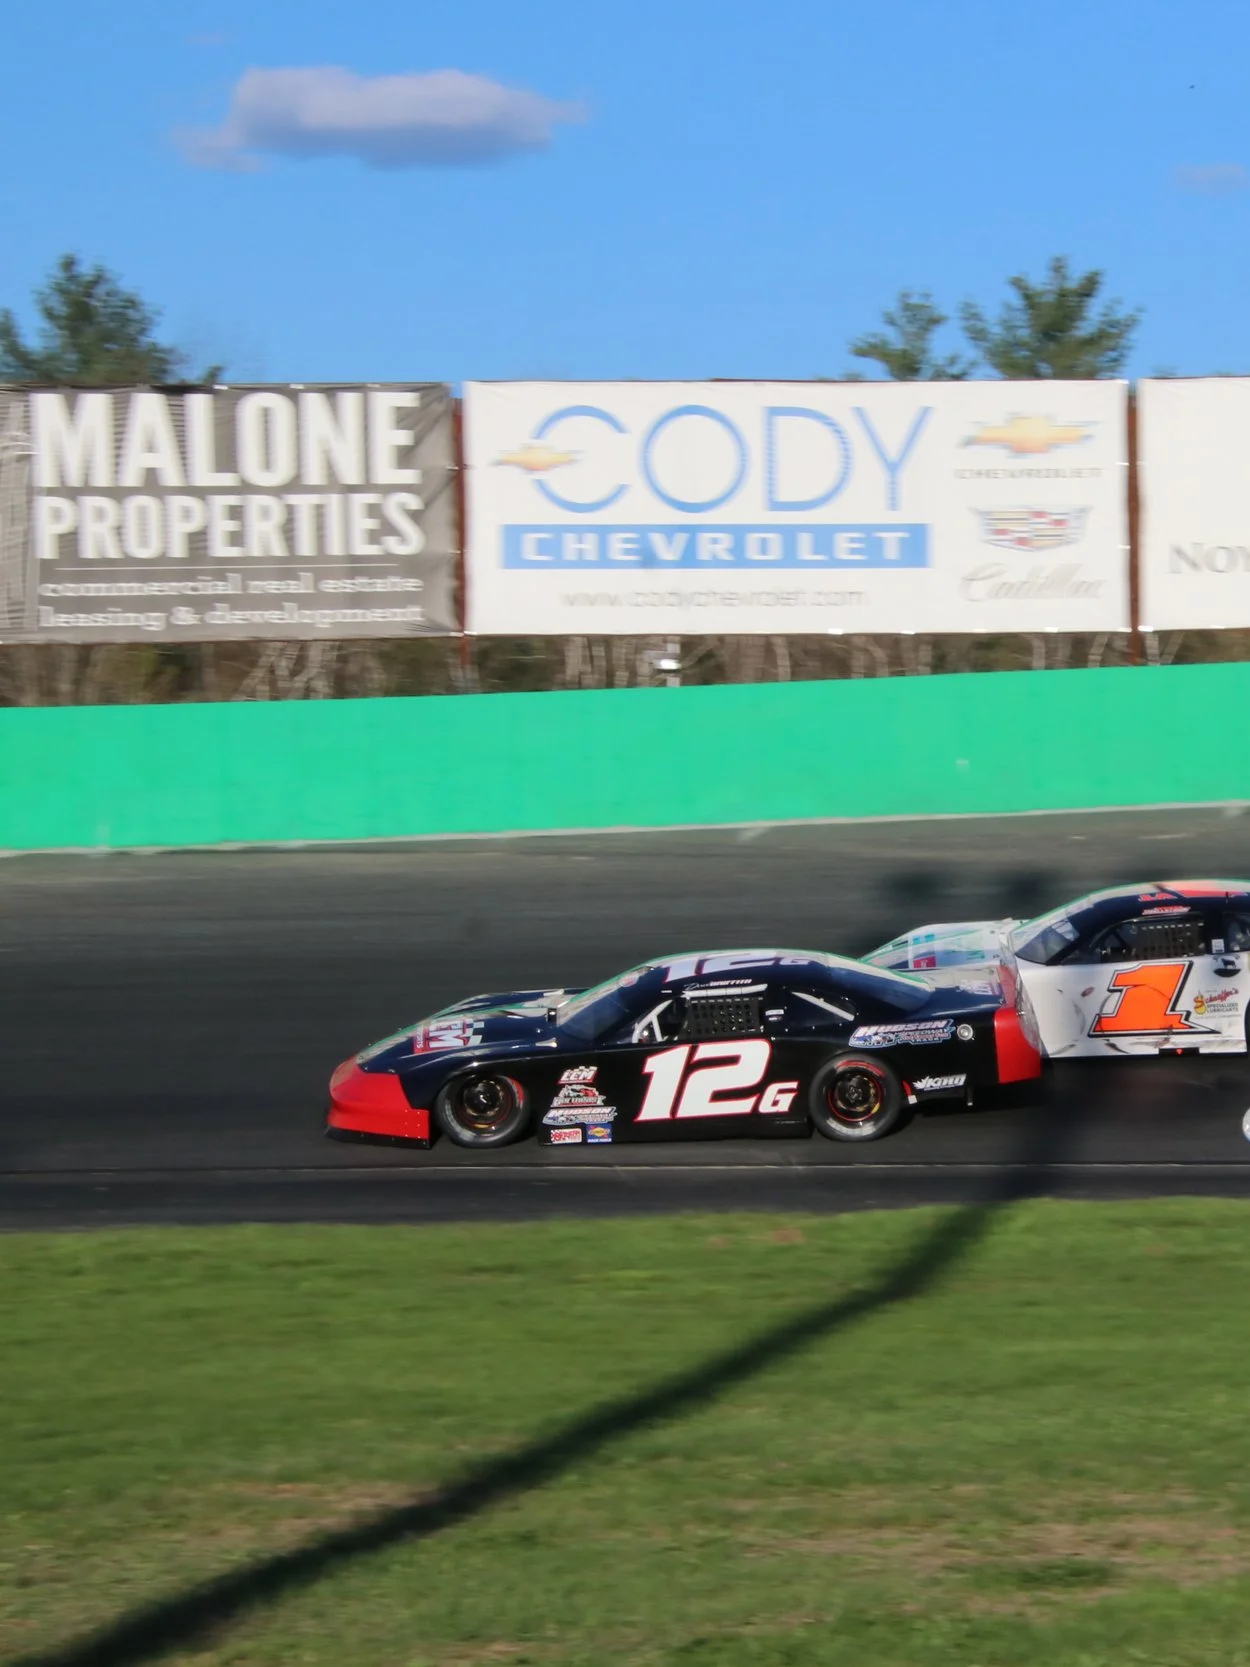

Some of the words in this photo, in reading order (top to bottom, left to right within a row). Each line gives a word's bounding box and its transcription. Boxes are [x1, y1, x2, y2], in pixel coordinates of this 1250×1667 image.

[29, 391, 423, 487] MALONE
[530, 405, 934, 514] CODY
[34, 491, 427, 560] PROPERTIES
[520, 531, 911, 563] CHEVROLET
[38, 573, 243, 598] commercial
[247, 572, 315, 594] real
[318, 573, 425, 593] estate
[170, 606, 201, 627] &
[1087, 960, 1218, 1037] 1
